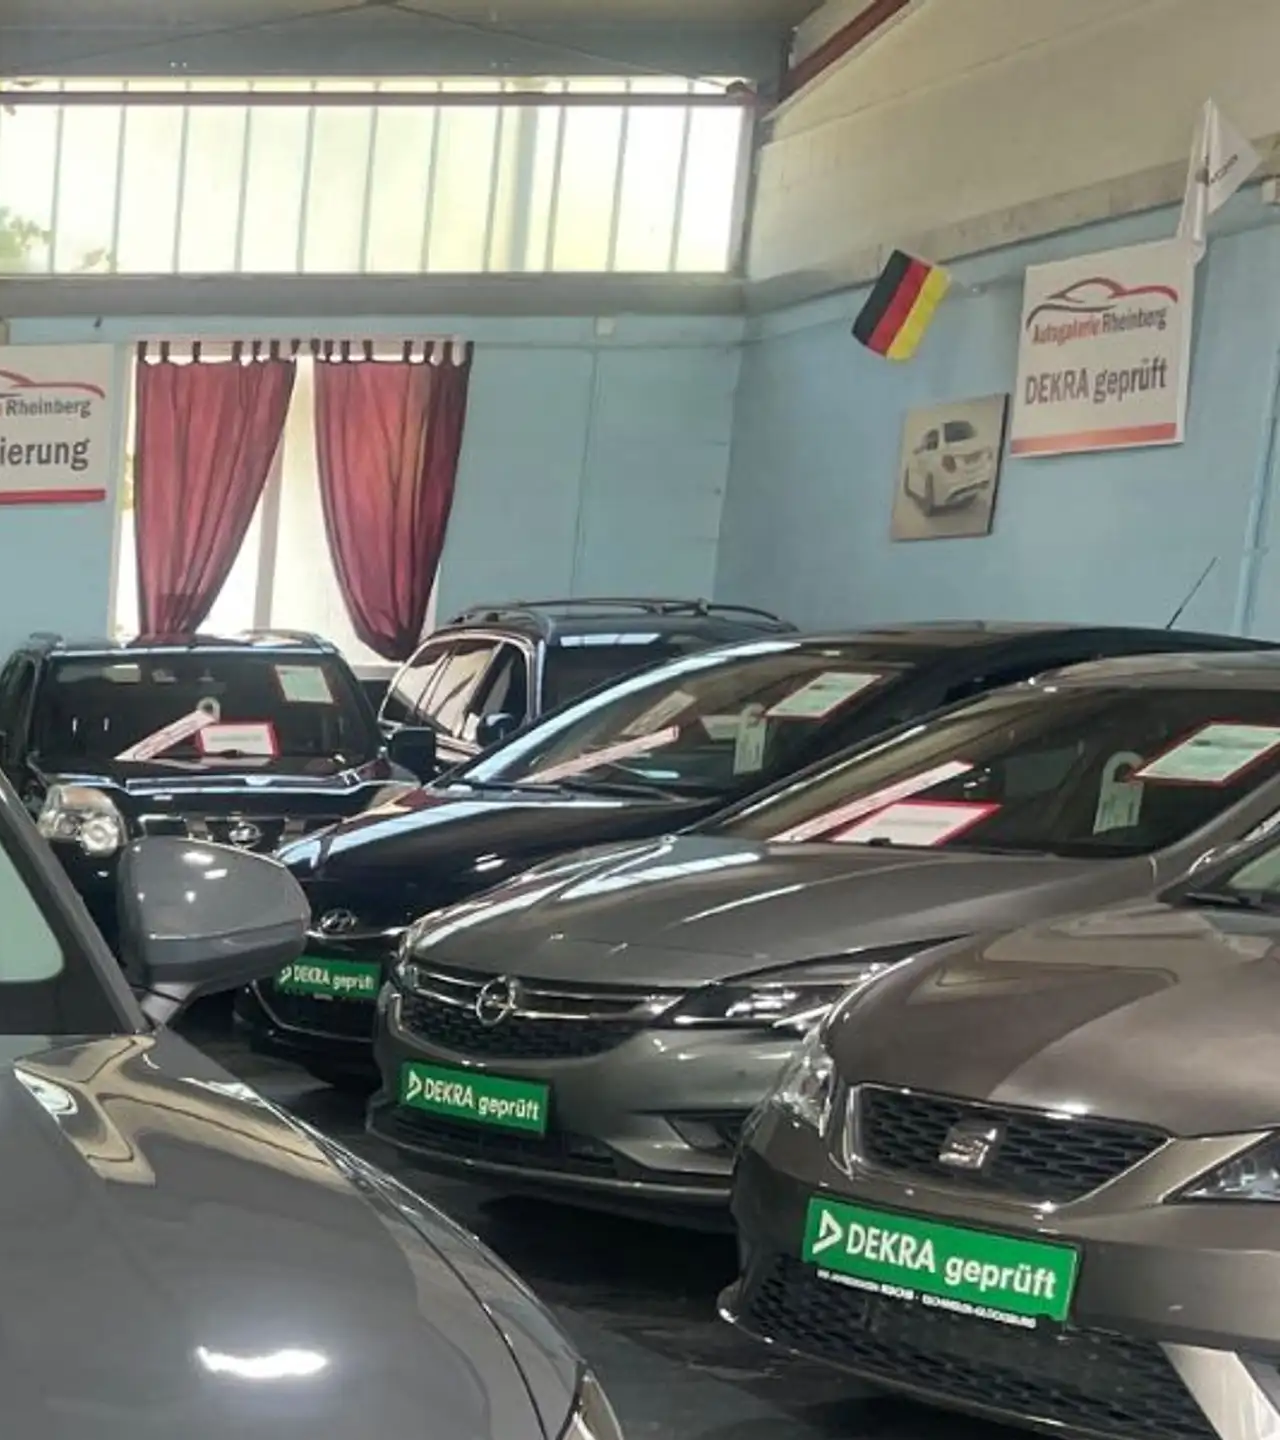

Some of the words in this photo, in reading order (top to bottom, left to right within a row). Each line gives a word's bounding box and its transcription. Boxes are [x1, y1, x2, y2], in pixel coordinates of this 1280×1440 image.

[1025, 367, 1090, 406] DEKRA
[1093, 356, 1168, 405] geprüft
[5, 397, 92, 419] Rheinberg
[423, 1077, 475, 1107] DEKRA
[478, 1095, 542, 1122] geprüft
[845, 1223, 937, 1275] DEKRA
[943, 1255, 1058, 1300] geprüft
